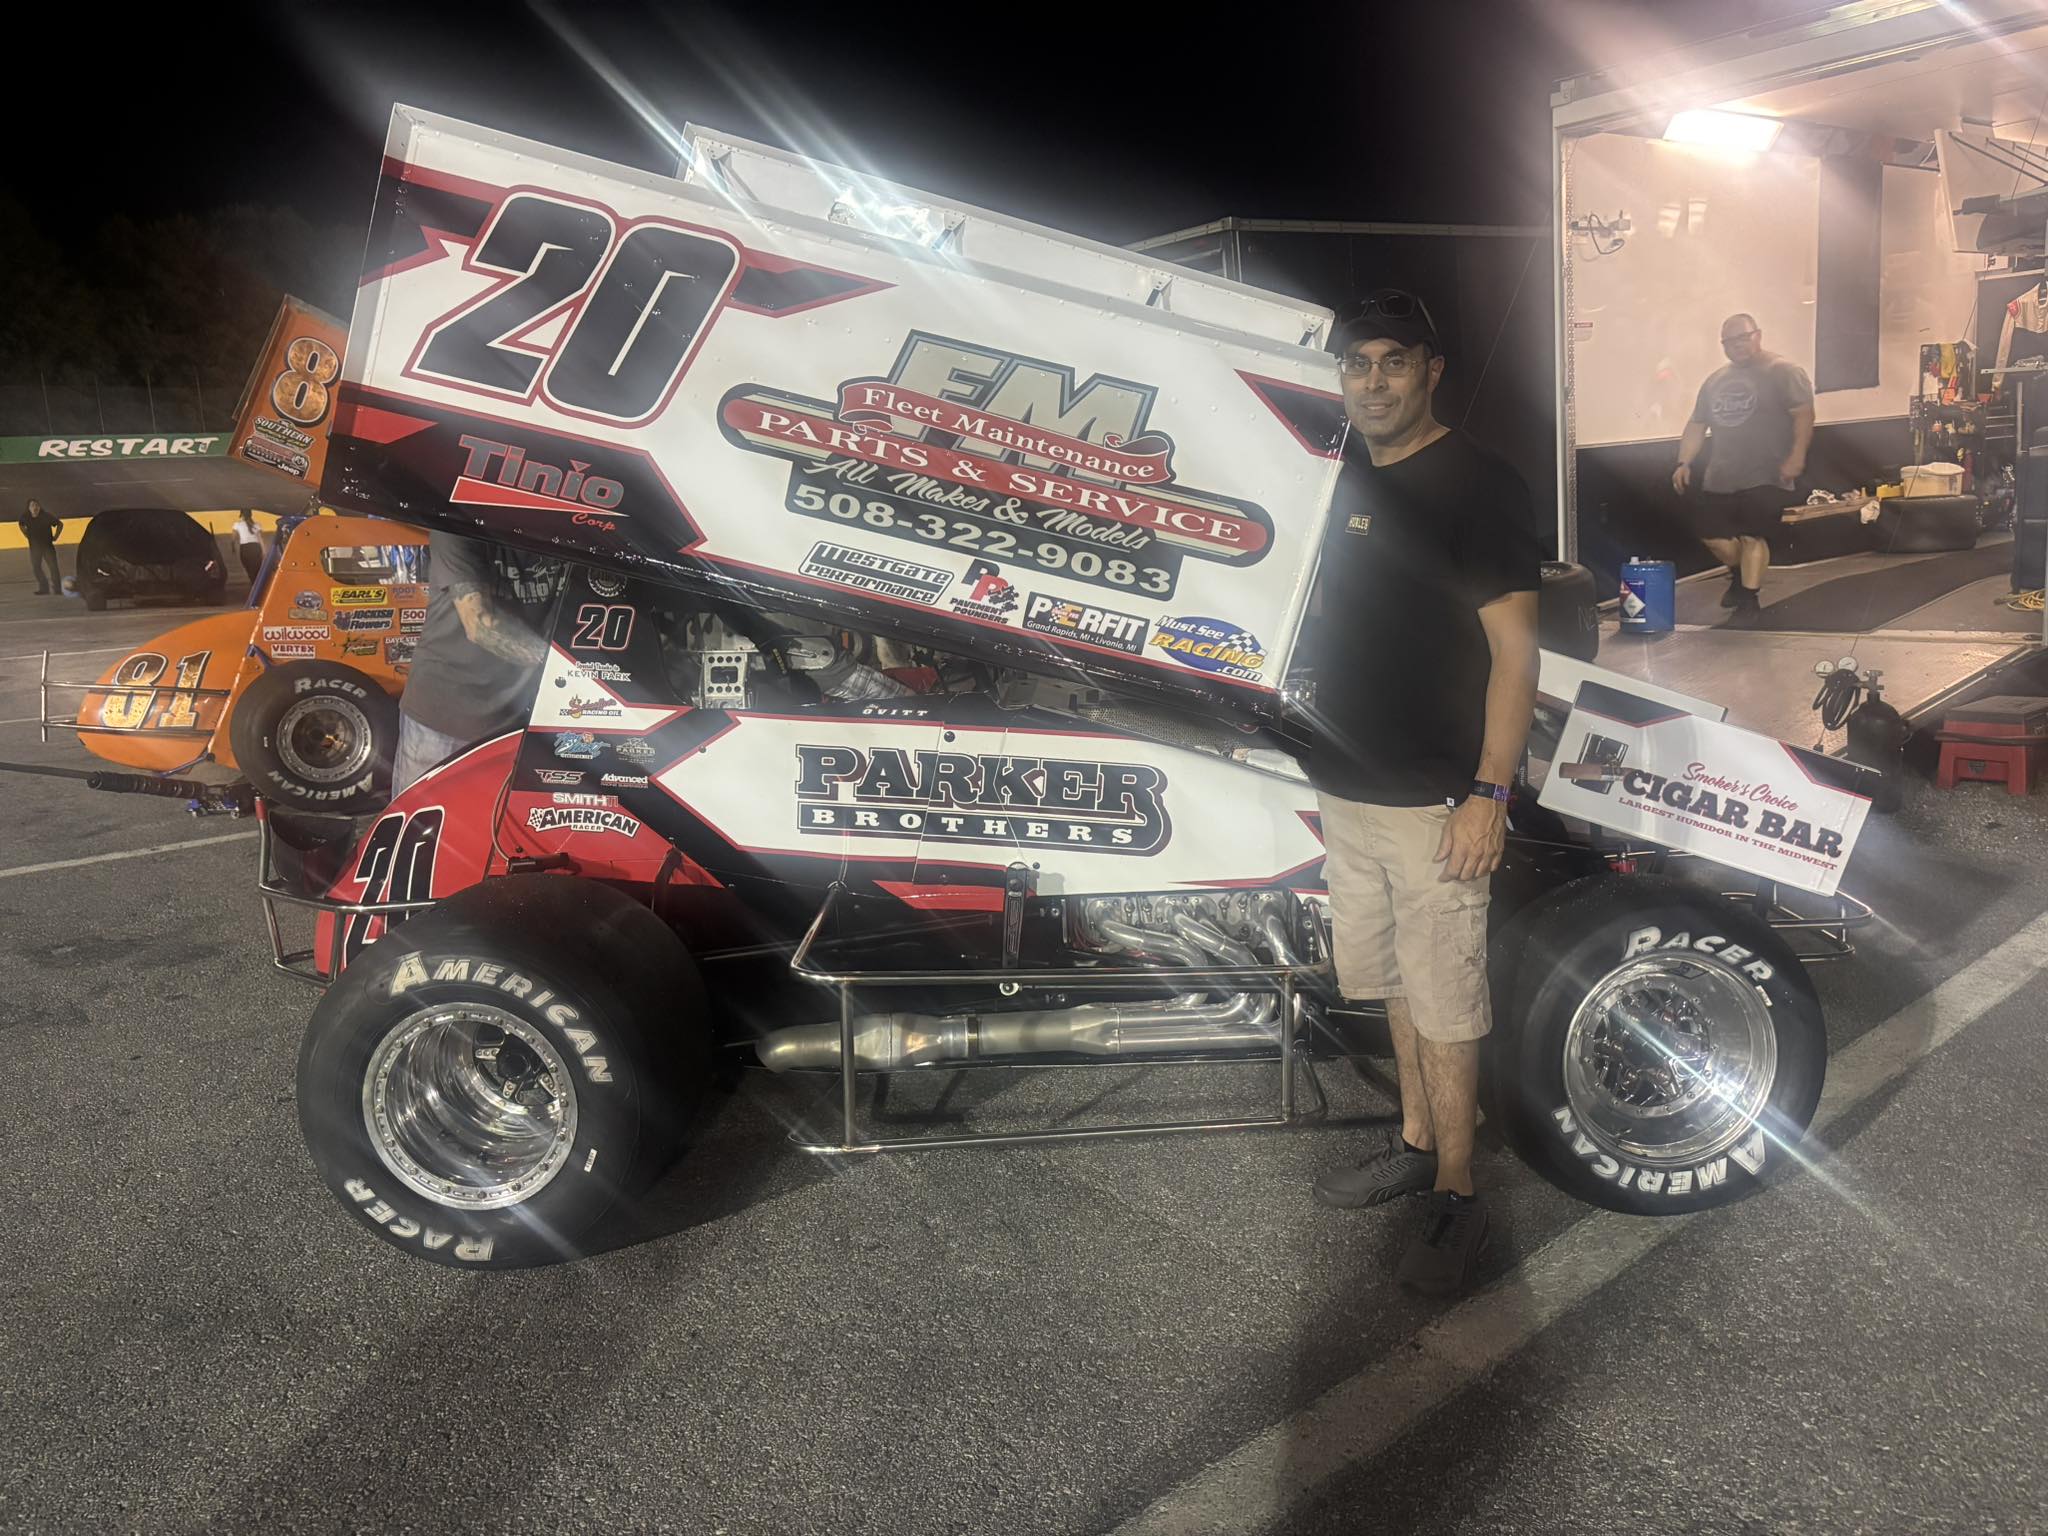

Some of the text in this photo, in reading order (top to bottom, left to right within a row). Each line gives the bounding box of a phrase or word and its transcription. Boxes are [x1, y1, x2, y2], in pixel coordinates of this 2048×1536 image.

[404, 188, 742, 426] 20
[271, 337, 340, 426] 8
[886, 329, 1159, 489] FM
[38, 437, 219, 457] RESTART
[255, 417, 313, 443] SOUTHERN
[862, 387, 1155, 478] Fleet Maintenance
[278, 463, 300, 476] Jeep
[459, 434, 625, 509] Tinio
[757, 411, 1242, 542] PARTS & SERVICE
[572, 511, 616, 531] Corp
[803, 459, 1151, 550] All Makes & Models
[793, 484, 1172, 593] 508-322-9083
[341, 589, 384, 598] EARL'S
[950, 597, 1004, 616] PAVEMENT
[402, 610, 425, 620] 500
[570, 602, 636, 650] 20
[953, 606, 1009, 625] POUNDERS
[1028, 596, 1146, 641] PERFIT
[1157, 616, 1225, 640] Must See
[264, 627, 330, 641] wilwood
[272, 645, 315, 653] VERTEX
[1027, 620, 1137, 652] Grand Rapids, MI Livonia, MI
[1149, 632, 1266, 670] RACING
[102, 651, 212, 729] 81
[294, 677, 368, 699] RACER
[567, 669, 632, 682] KEVIN PARK
[1215, 663, 1264, 683] .com
[862, 708, 929, 717] OVITT
[267, 770, 373, 800] AMERICAN
[535, 769, 586, 781] TSS
[601, 773, 648, 784] Advanced
[796, 744, 1163, 822] PARKER
[1681, 761, 1799, 812] Smoker's Choice
[539, 808, 640, 835] AMERICAN
[812, 808, 1134, 844] BROTHERS
[1623, 768, 1844, 858] CIGAR BAR
[1619, 797, 1838, 870] LARGEST HUMIDOR IN THE MIDWEST
[1622, 926, 1776, 981] RACER
[390, 951, 614, 1083] AMERICAN
[1552, 1106, 1767, 1194] AMERICAN
[343, 1177, 495, 1262] RACER
